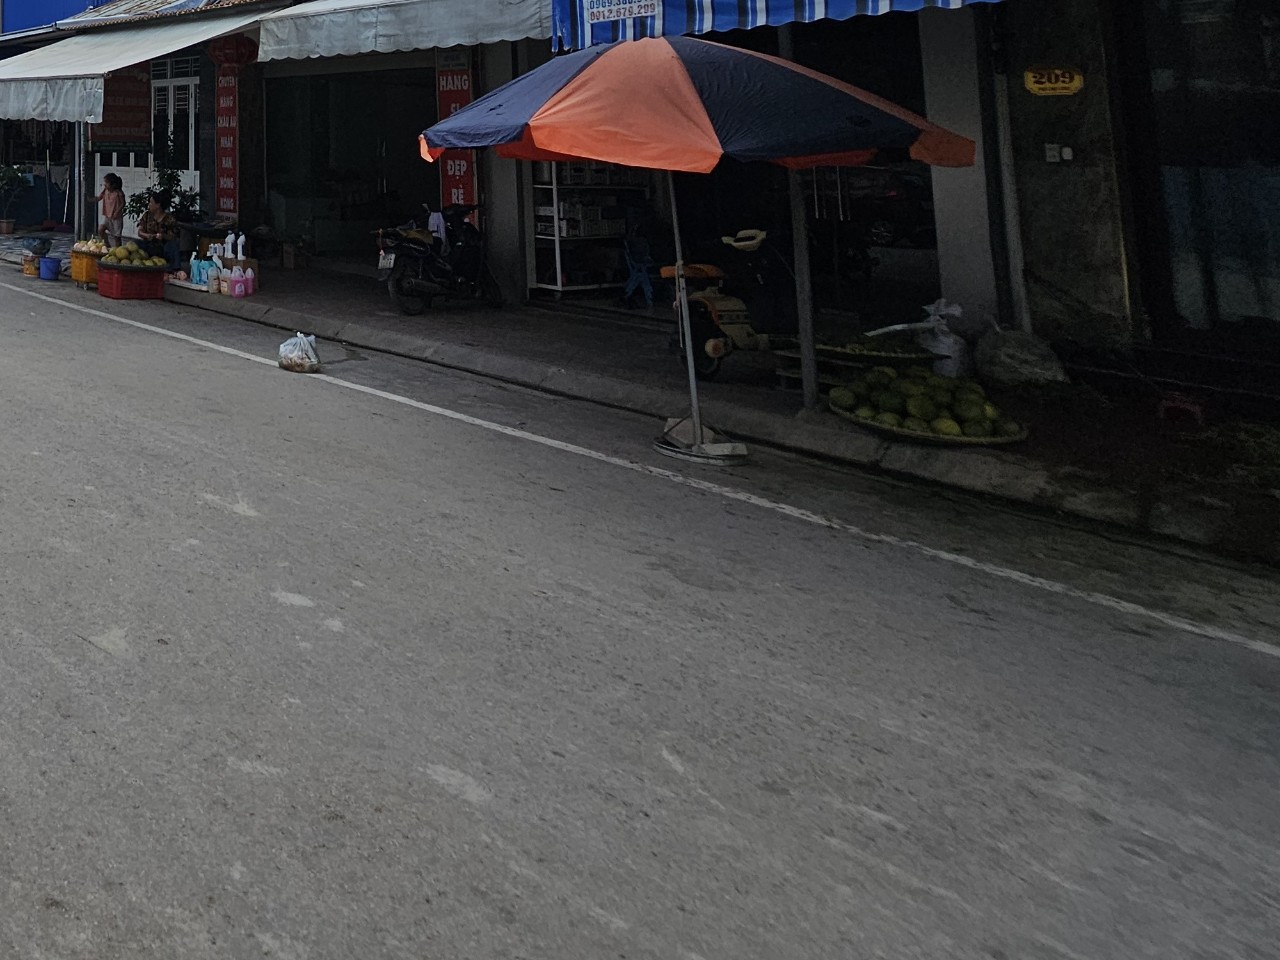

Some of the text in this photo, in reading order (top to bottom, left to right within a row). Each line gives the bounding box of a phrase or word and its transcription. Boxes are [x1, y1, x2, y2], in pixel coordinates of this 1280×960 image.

[439, 72, 470, 91] HÀNG
[1032, 69, 1076, 85] 209
[447, 159, 467, 180] ĐẸP
